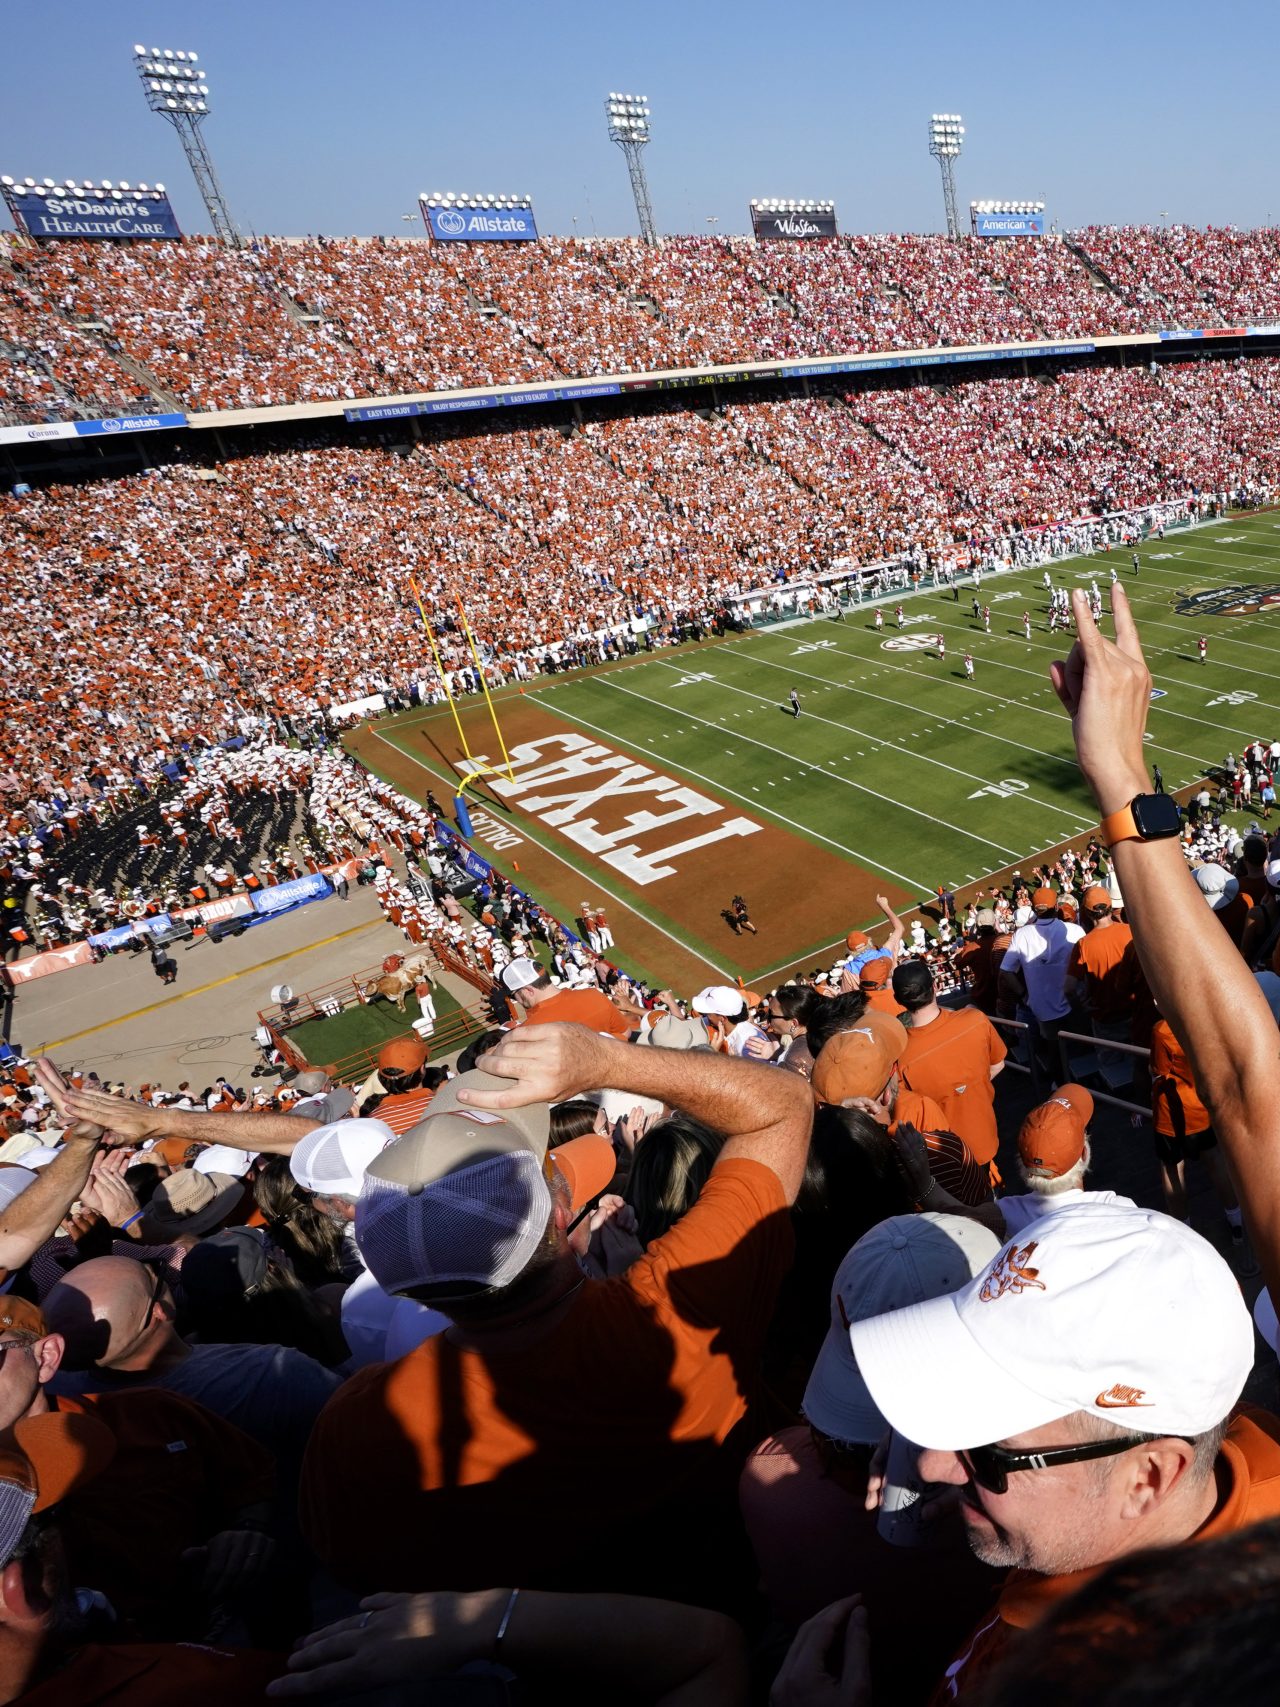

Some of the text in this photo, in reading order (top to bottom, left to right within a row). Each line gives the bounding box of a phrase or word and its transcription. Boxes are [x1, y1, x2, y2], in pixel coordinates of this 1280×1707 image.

[467, 217, 526, 232] Allstate
[982, 219, 1026, 230] American
[798, 367, 810, 375] EASY
[657, 381, 663, 389] 7
[697, 376, 715, 385] 2:46
[510, 395, 525, 403] EASY
[367, 410, 383, 418] EASY
[392, 407, 410, 415] ENJOY
[121, 418, 161, 429] Allstate
[27, 429, 60, 439] Corona
[1179, 583, 1280, 616] RED RIVER
[797, 639, 838, 652] 20
[680, 671, 717, 684] 10
[1216, 690, 1259, 705] 30
[981, 778, 1030, 798] 10
[454, 733, 765, 886] TEXAS
[469, 812, 524, 851] DALLAS
[278, 880, 320, 900] Allstate
[1106, 1383, 1147, 1404] NIKE
